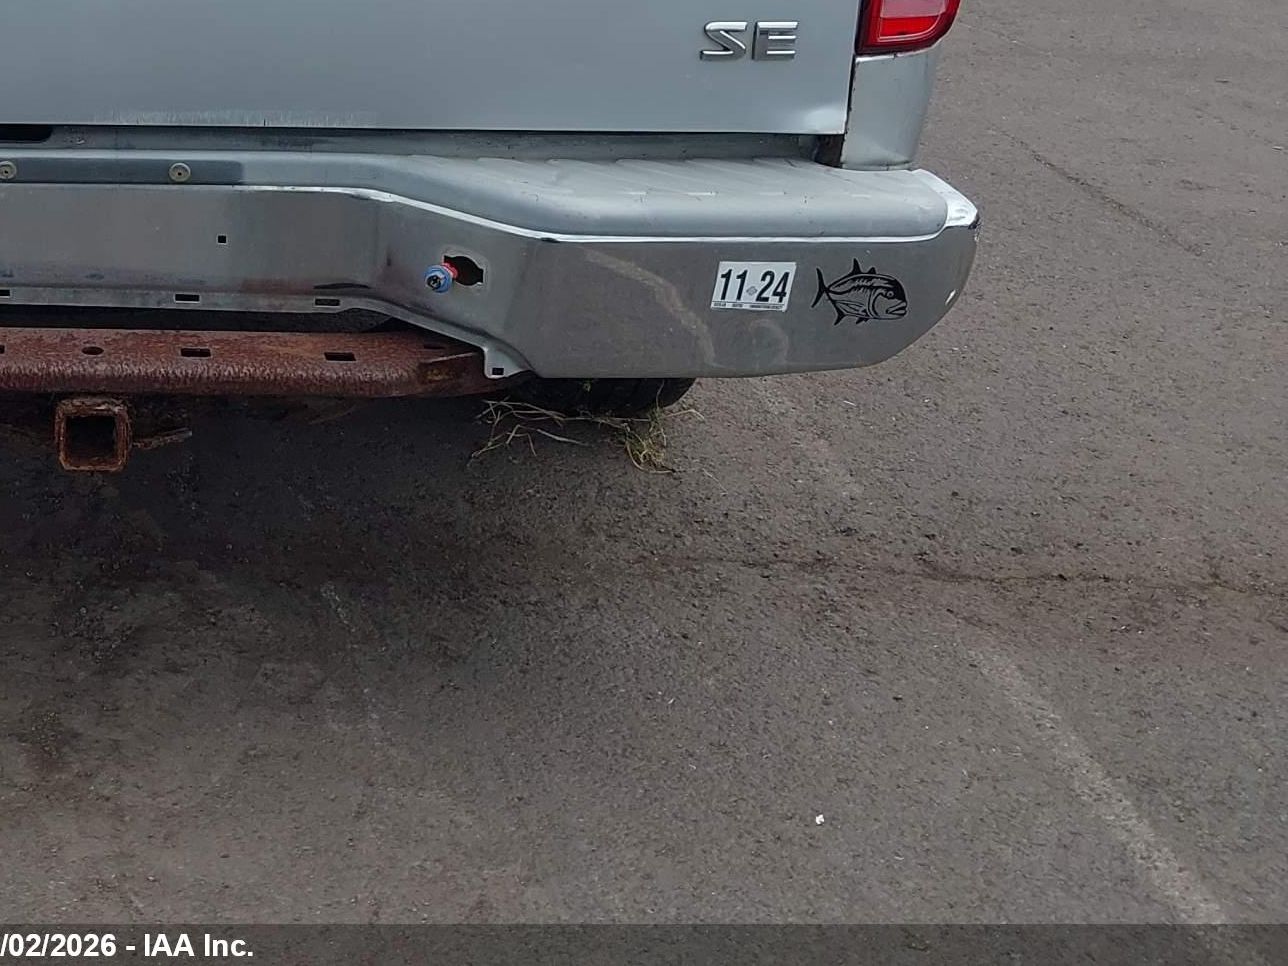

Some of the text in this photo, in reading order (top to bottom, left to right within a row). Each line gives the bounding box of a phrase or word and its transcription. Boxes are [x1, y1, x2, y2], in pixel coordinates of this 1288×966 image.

[699, 20, 799, 60] SE
[720, 268, 790, 303] 11 24
